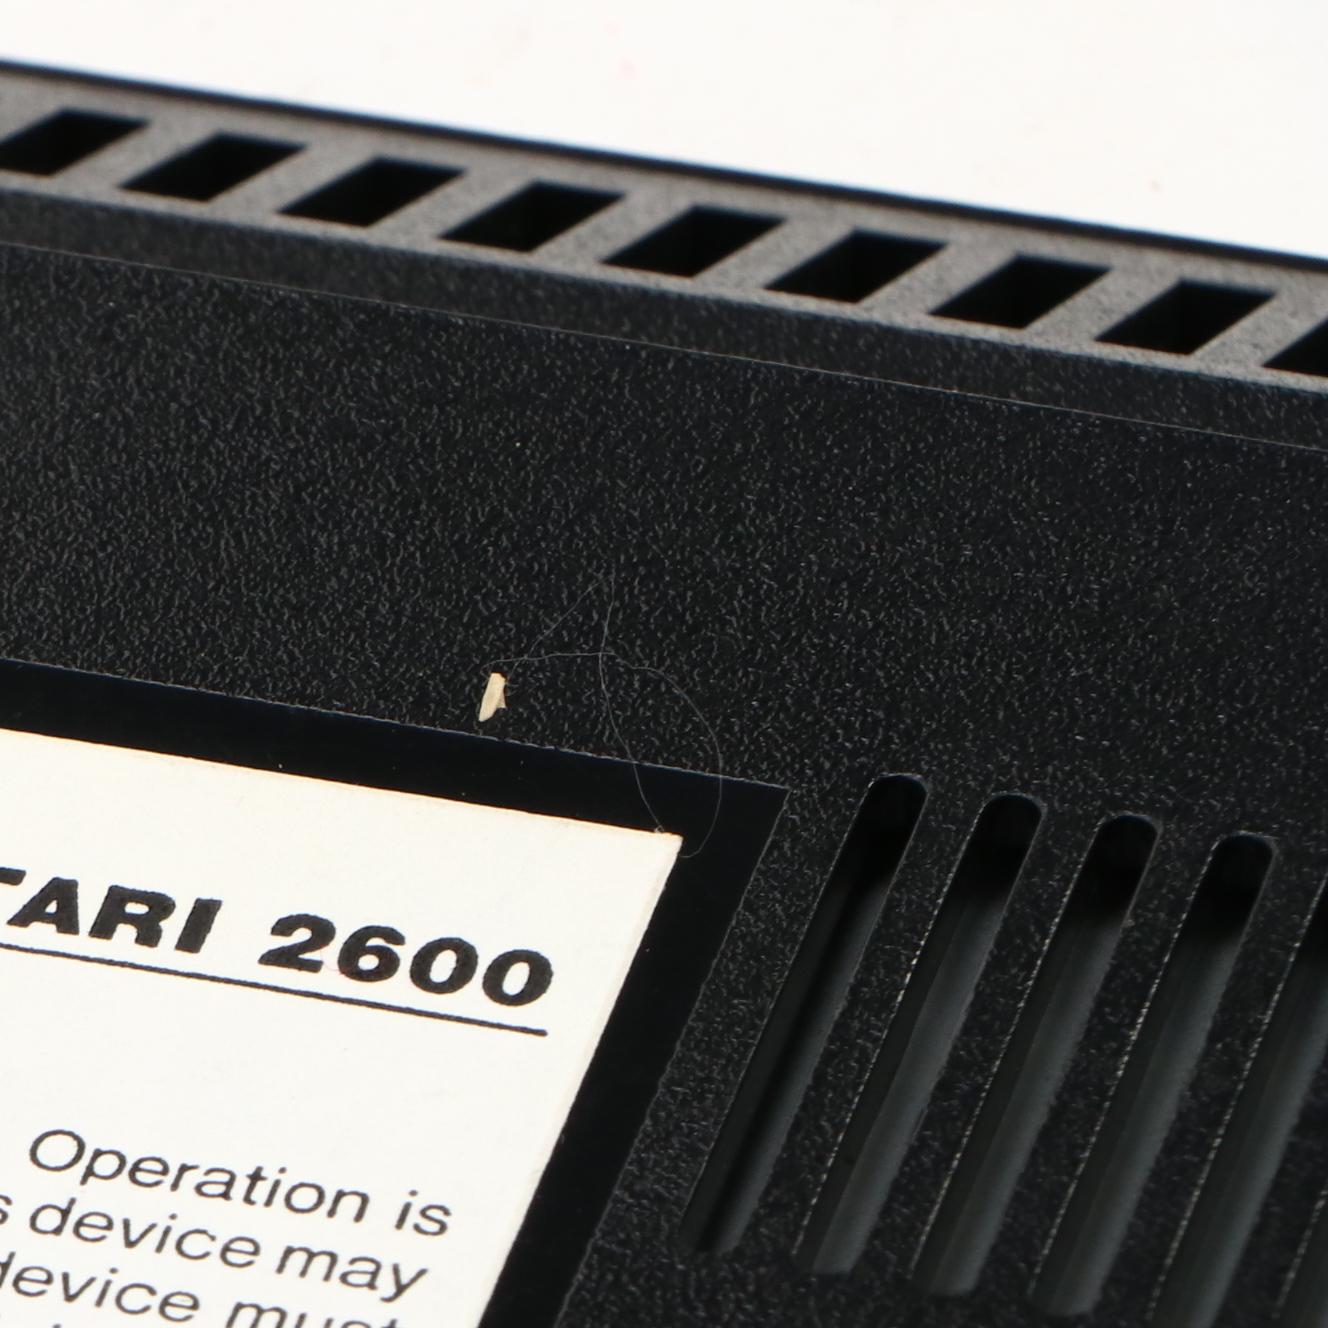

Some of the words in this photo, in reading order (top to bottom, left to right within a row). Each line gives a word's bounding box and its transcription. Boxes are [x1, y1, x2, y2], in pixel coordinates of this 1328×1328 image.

[256, 912, 555, 1008] 2600
[28, 1128, 370, 1224] Operation
[394, 1192, 452, 1237] is
[28, 1196, 261, 1269] device
[275, 1245, 428, 1304] may
